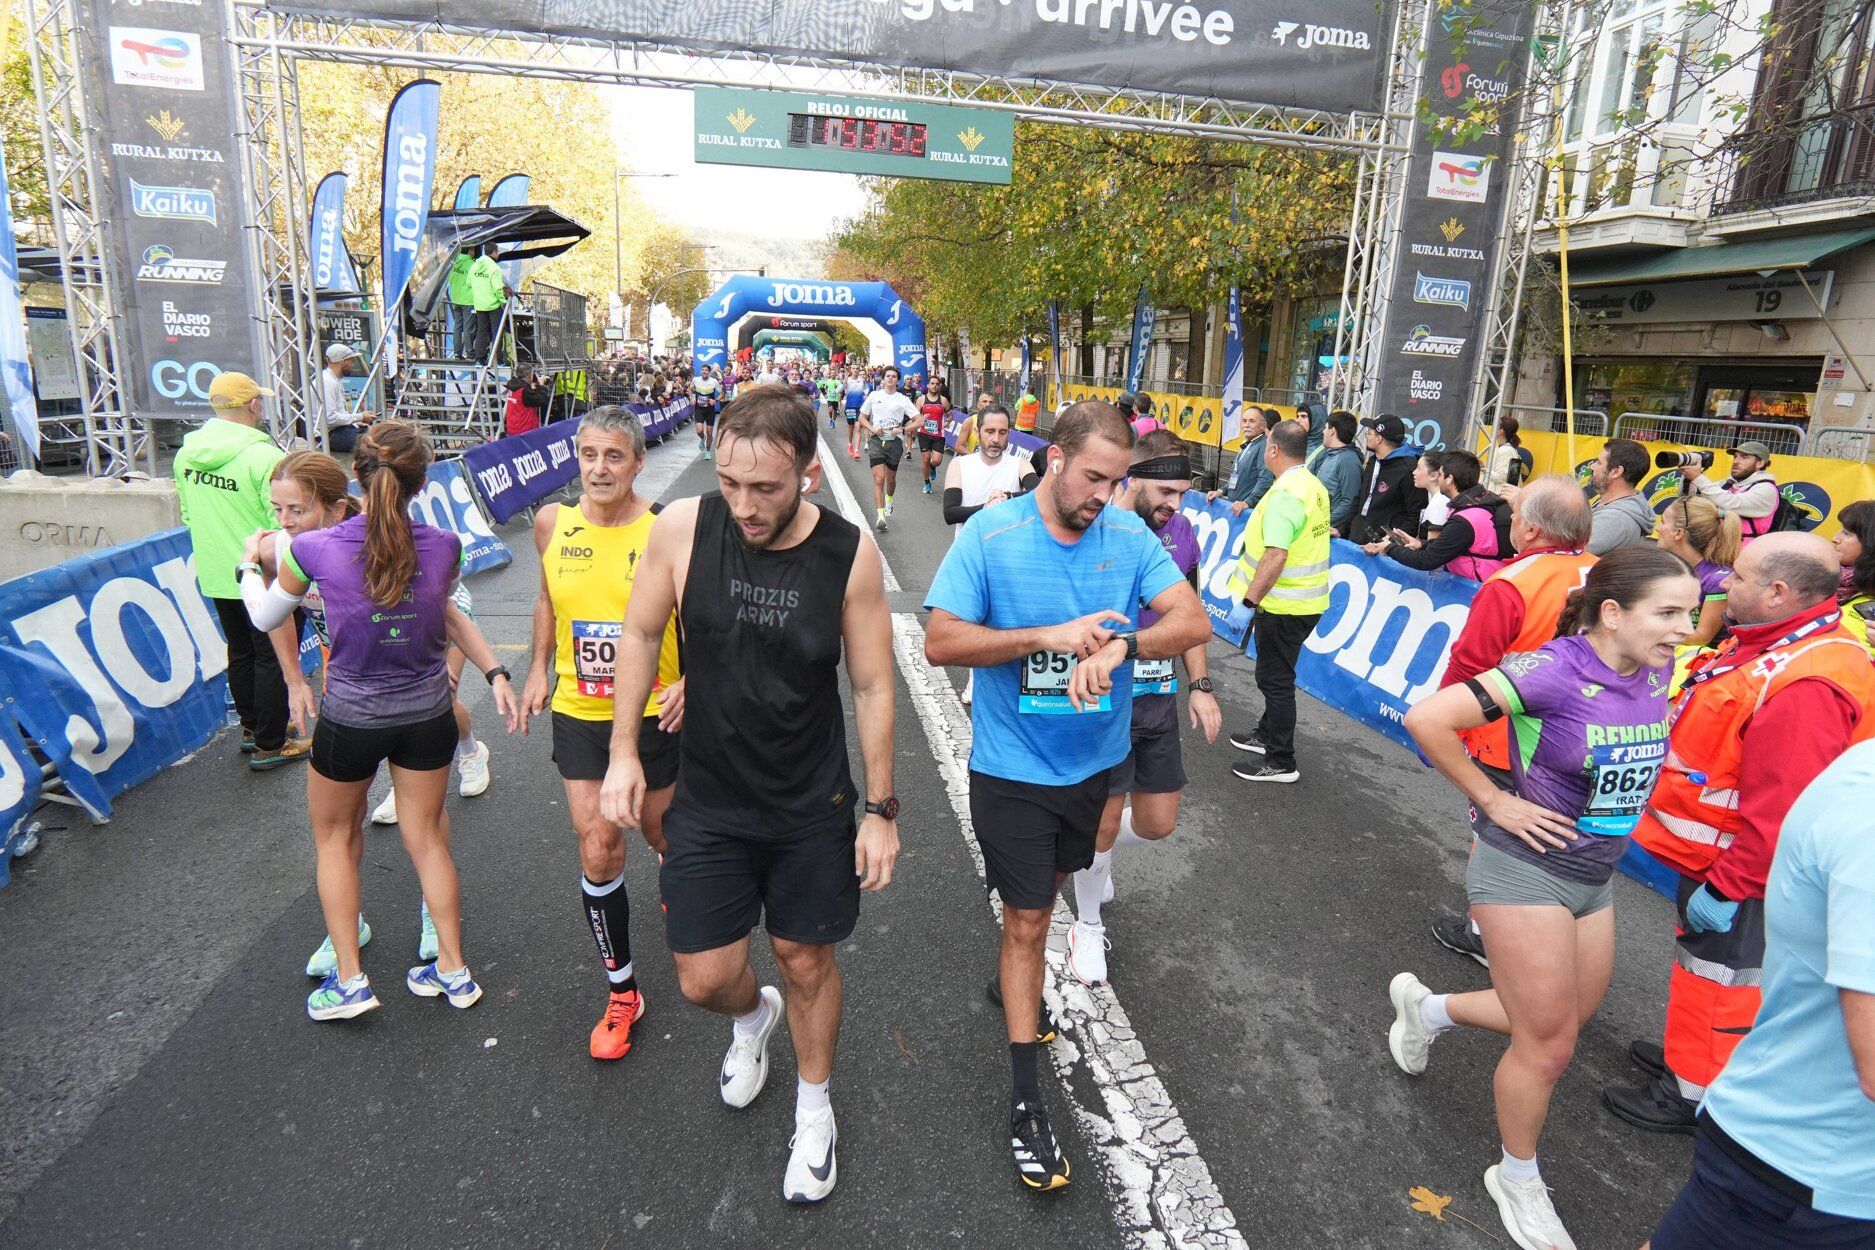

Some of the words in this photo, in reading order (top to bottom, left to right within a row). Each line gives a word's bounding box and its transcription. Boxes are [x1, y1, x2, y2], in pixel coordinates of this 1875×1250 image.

[124, 70, 195, 84] TotalEnergies
[1466, 74, 1508, 94] forum
[807, 101, 850, 117] RELOJ
[854, 105, 908, 121] OFICIAL
[698, 134, 737, 147] RURAL
[739, 136, 782, 149] KUTXA
[111, 143, 166, 159] RURAL
[167, 147, 225, 162] KUTXA
[930, 151, 966, 163] RURAL
[969, 154, 1008, 167] KUTXA
[1435, 186, 1480, 199] TotalEnergies
[140, 190, 208, 216] Kaiku
[1411, 244, 1446, 257] RURAL
[1447, 247, 1485, 260] KUTXA
[137, 265, 225, 281] RUNNING
[767, 282, 856, 307] Joma
[1419, 281, 1465, 302] Kaiku
[162, 301, 178, 312] EL
[1755, 290, 1782, 313] 19
[163, 312, 211, 326] DIARIO
[164, 324, 211, 338] VASCO
[334, 328, 363, 341] ADE
[1402, 340, 1462, 355] RUNNING
[1412, 370, 1423, 380] EL
[1410, 380, 1443, 391] DIARIO
[1410, 389, 1441, 400] VASCO
[193, 470, 239, 492] Joma
[20, 521, 116, 547] ORMA
[561, 546, 593, 558] INDO
[730, 578, 800, 608] PROZIS
[736, 603, 790, 627] ARMY
[582, 641, 616, 663] 50
[593, 667, 616, 675] MAR
[1624, 742, 1665, 764] Joma
